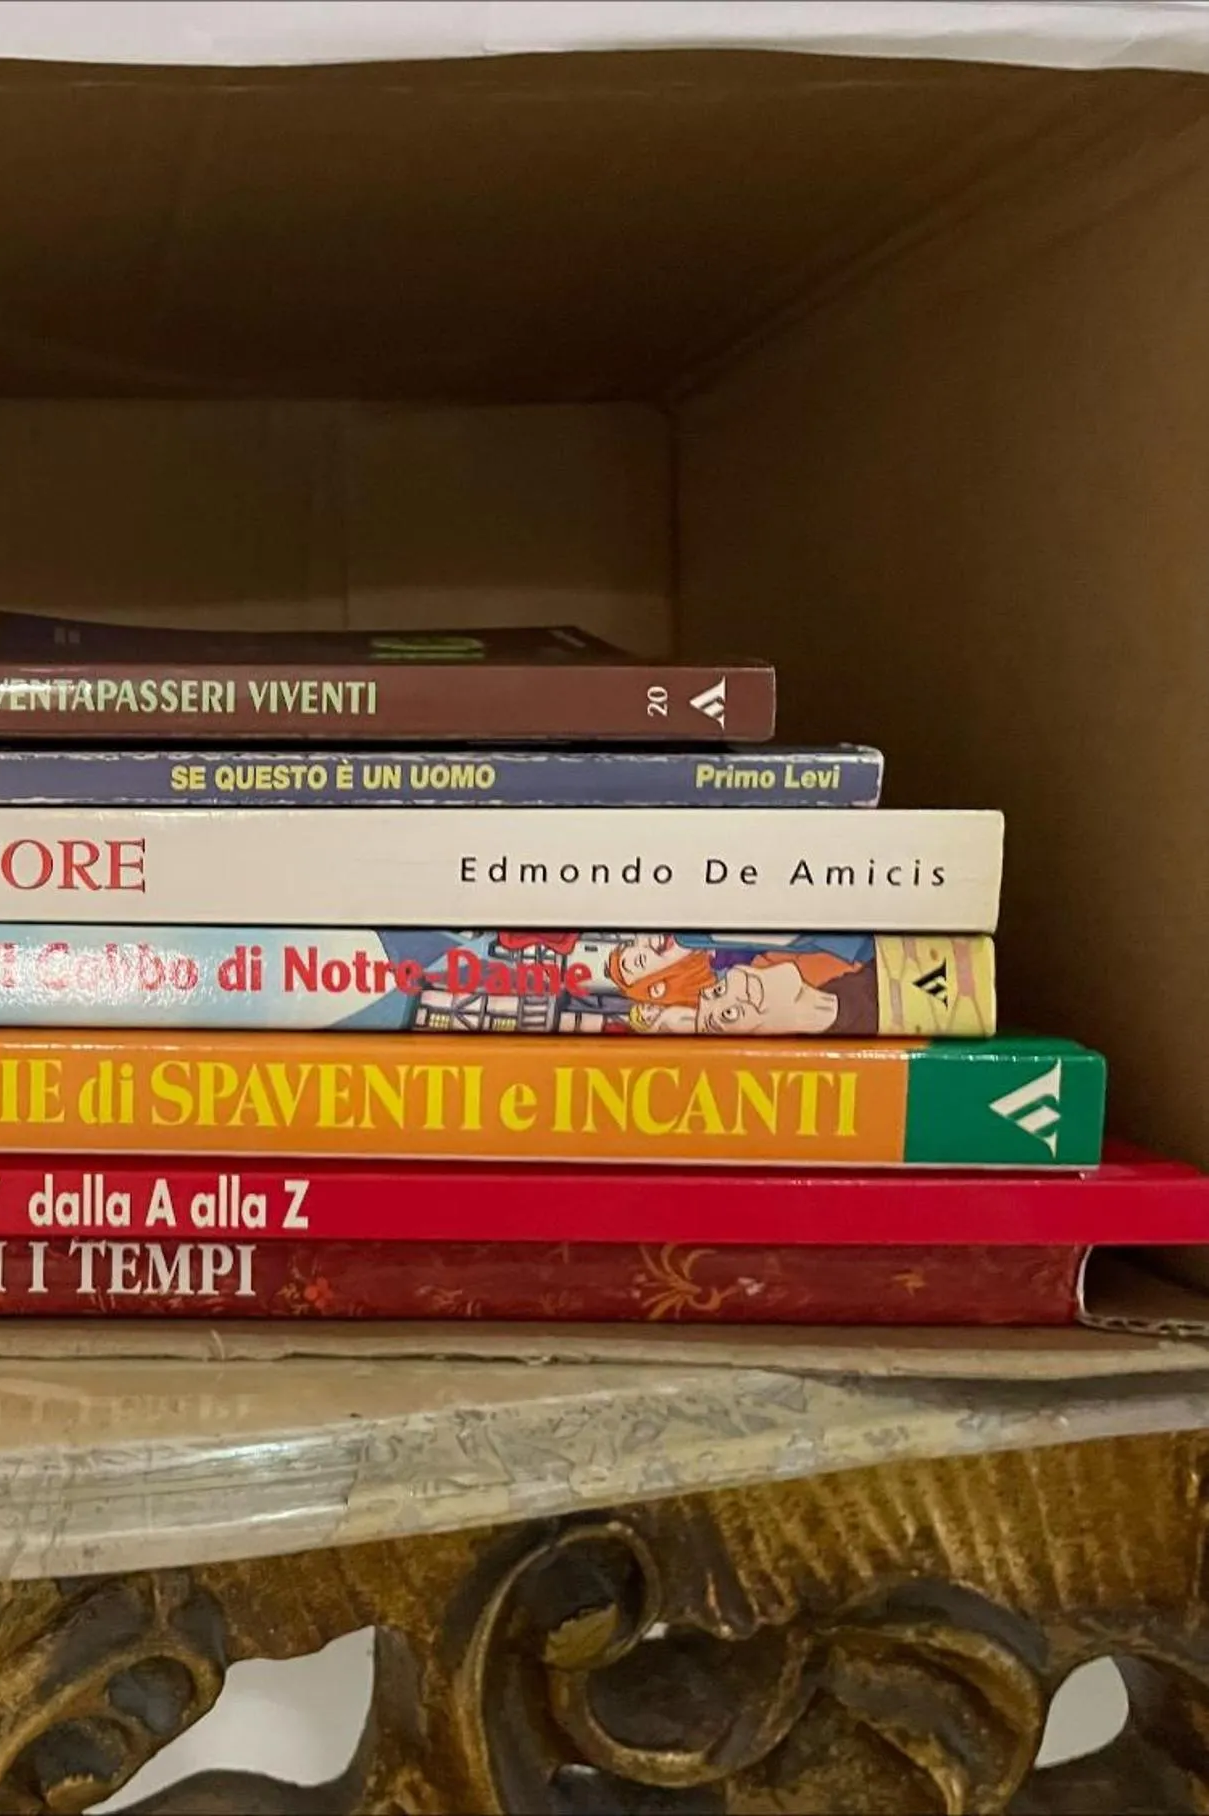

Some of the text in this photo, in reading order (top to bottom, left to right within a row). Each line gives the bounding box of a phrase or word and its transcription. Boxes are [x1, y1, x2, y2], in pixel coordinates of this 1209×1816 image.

[247, 680, 379, 716] VIVENTI
[646, 685, 669, 717] 20
[170, 759, 497, 792] SE QUESTO È UN UOMO
[695, 765, 841, 790] Primo Levi
[461, 857, 946, 888] Edmondo De Amicis
[217, 944, 262, 992] di
[284, 945, 591, 998] Notre-Dame
[77, 1060, 135, 1127] di
[150, 1061, 482, 1130] SPAVENTI
[498, 1083, 538, 1132] e
[551, 1068, 858, 1138] INCANTI
[28, 1173, 129, 1228] dalla
[144, 1181, 178, 1228] A
[189, 1175, 267, 1229] alla
[282, 1180, 309, 1230] Z
[26, 1243, 49, 1294] I
[68, 1242, 257, 1297] TEMPI
